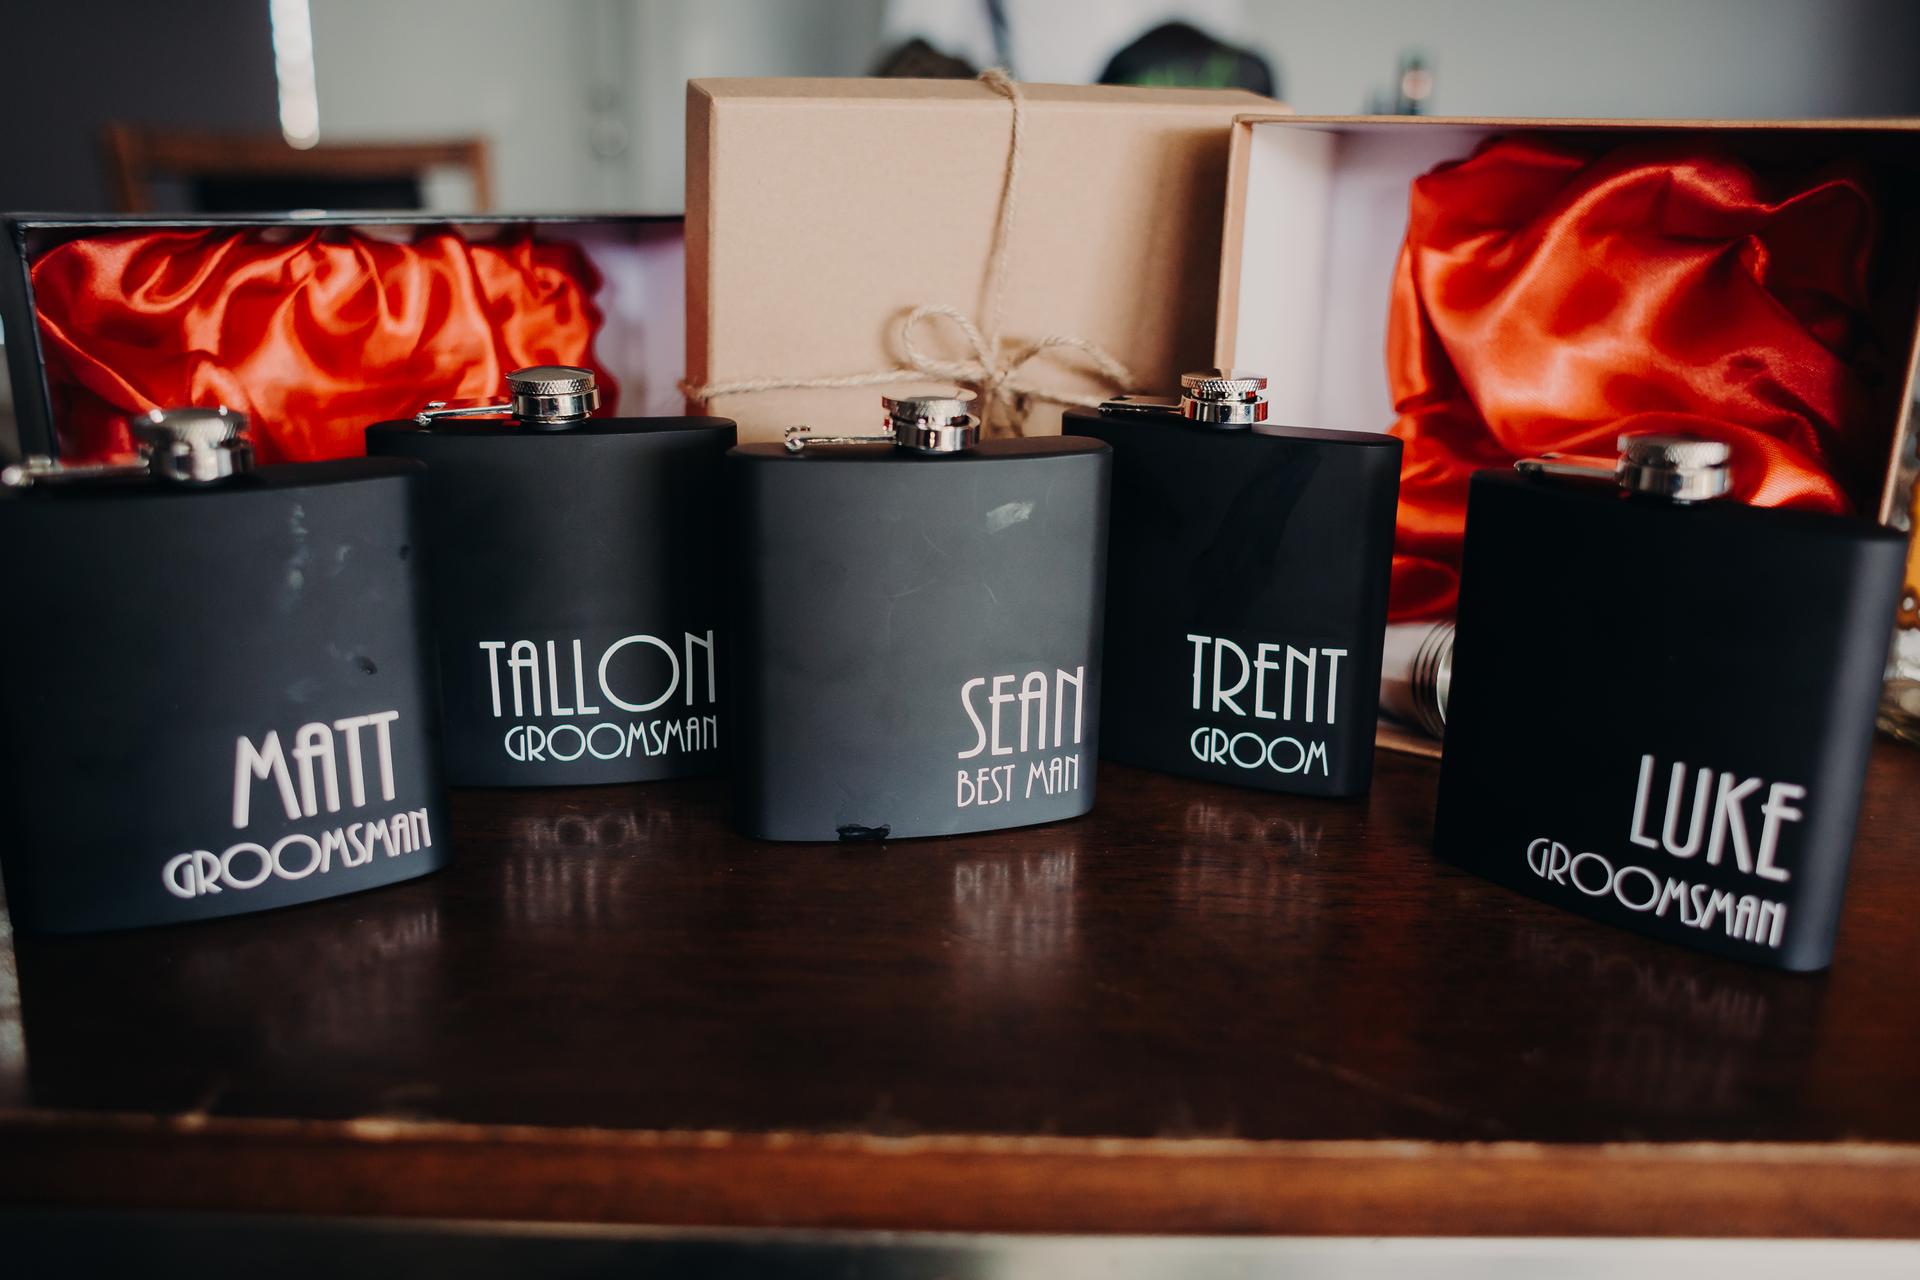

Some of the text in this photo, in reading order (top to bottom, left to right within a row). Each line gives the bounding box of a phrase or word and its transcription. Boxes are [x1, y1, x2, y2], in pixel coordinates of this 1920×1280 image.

[479, 630, 718, 717] TALLON
[957, 666, 1085, 760] SEAN
[1186, 633, 1348, 725] TRENT
[231, 709, 400, 829] MATT
[503, 714, 719, 763] GROOMSMAN
[956, 753, 1080, 808] BEST MAN
[1190, 726, 1329, 777] GROOM
[162, 806, 433, 900] GROOMSMAN
[1629, 754, 1808, 882] LUKE
[1526, 836, 1787, 949] GROOMSMAN
